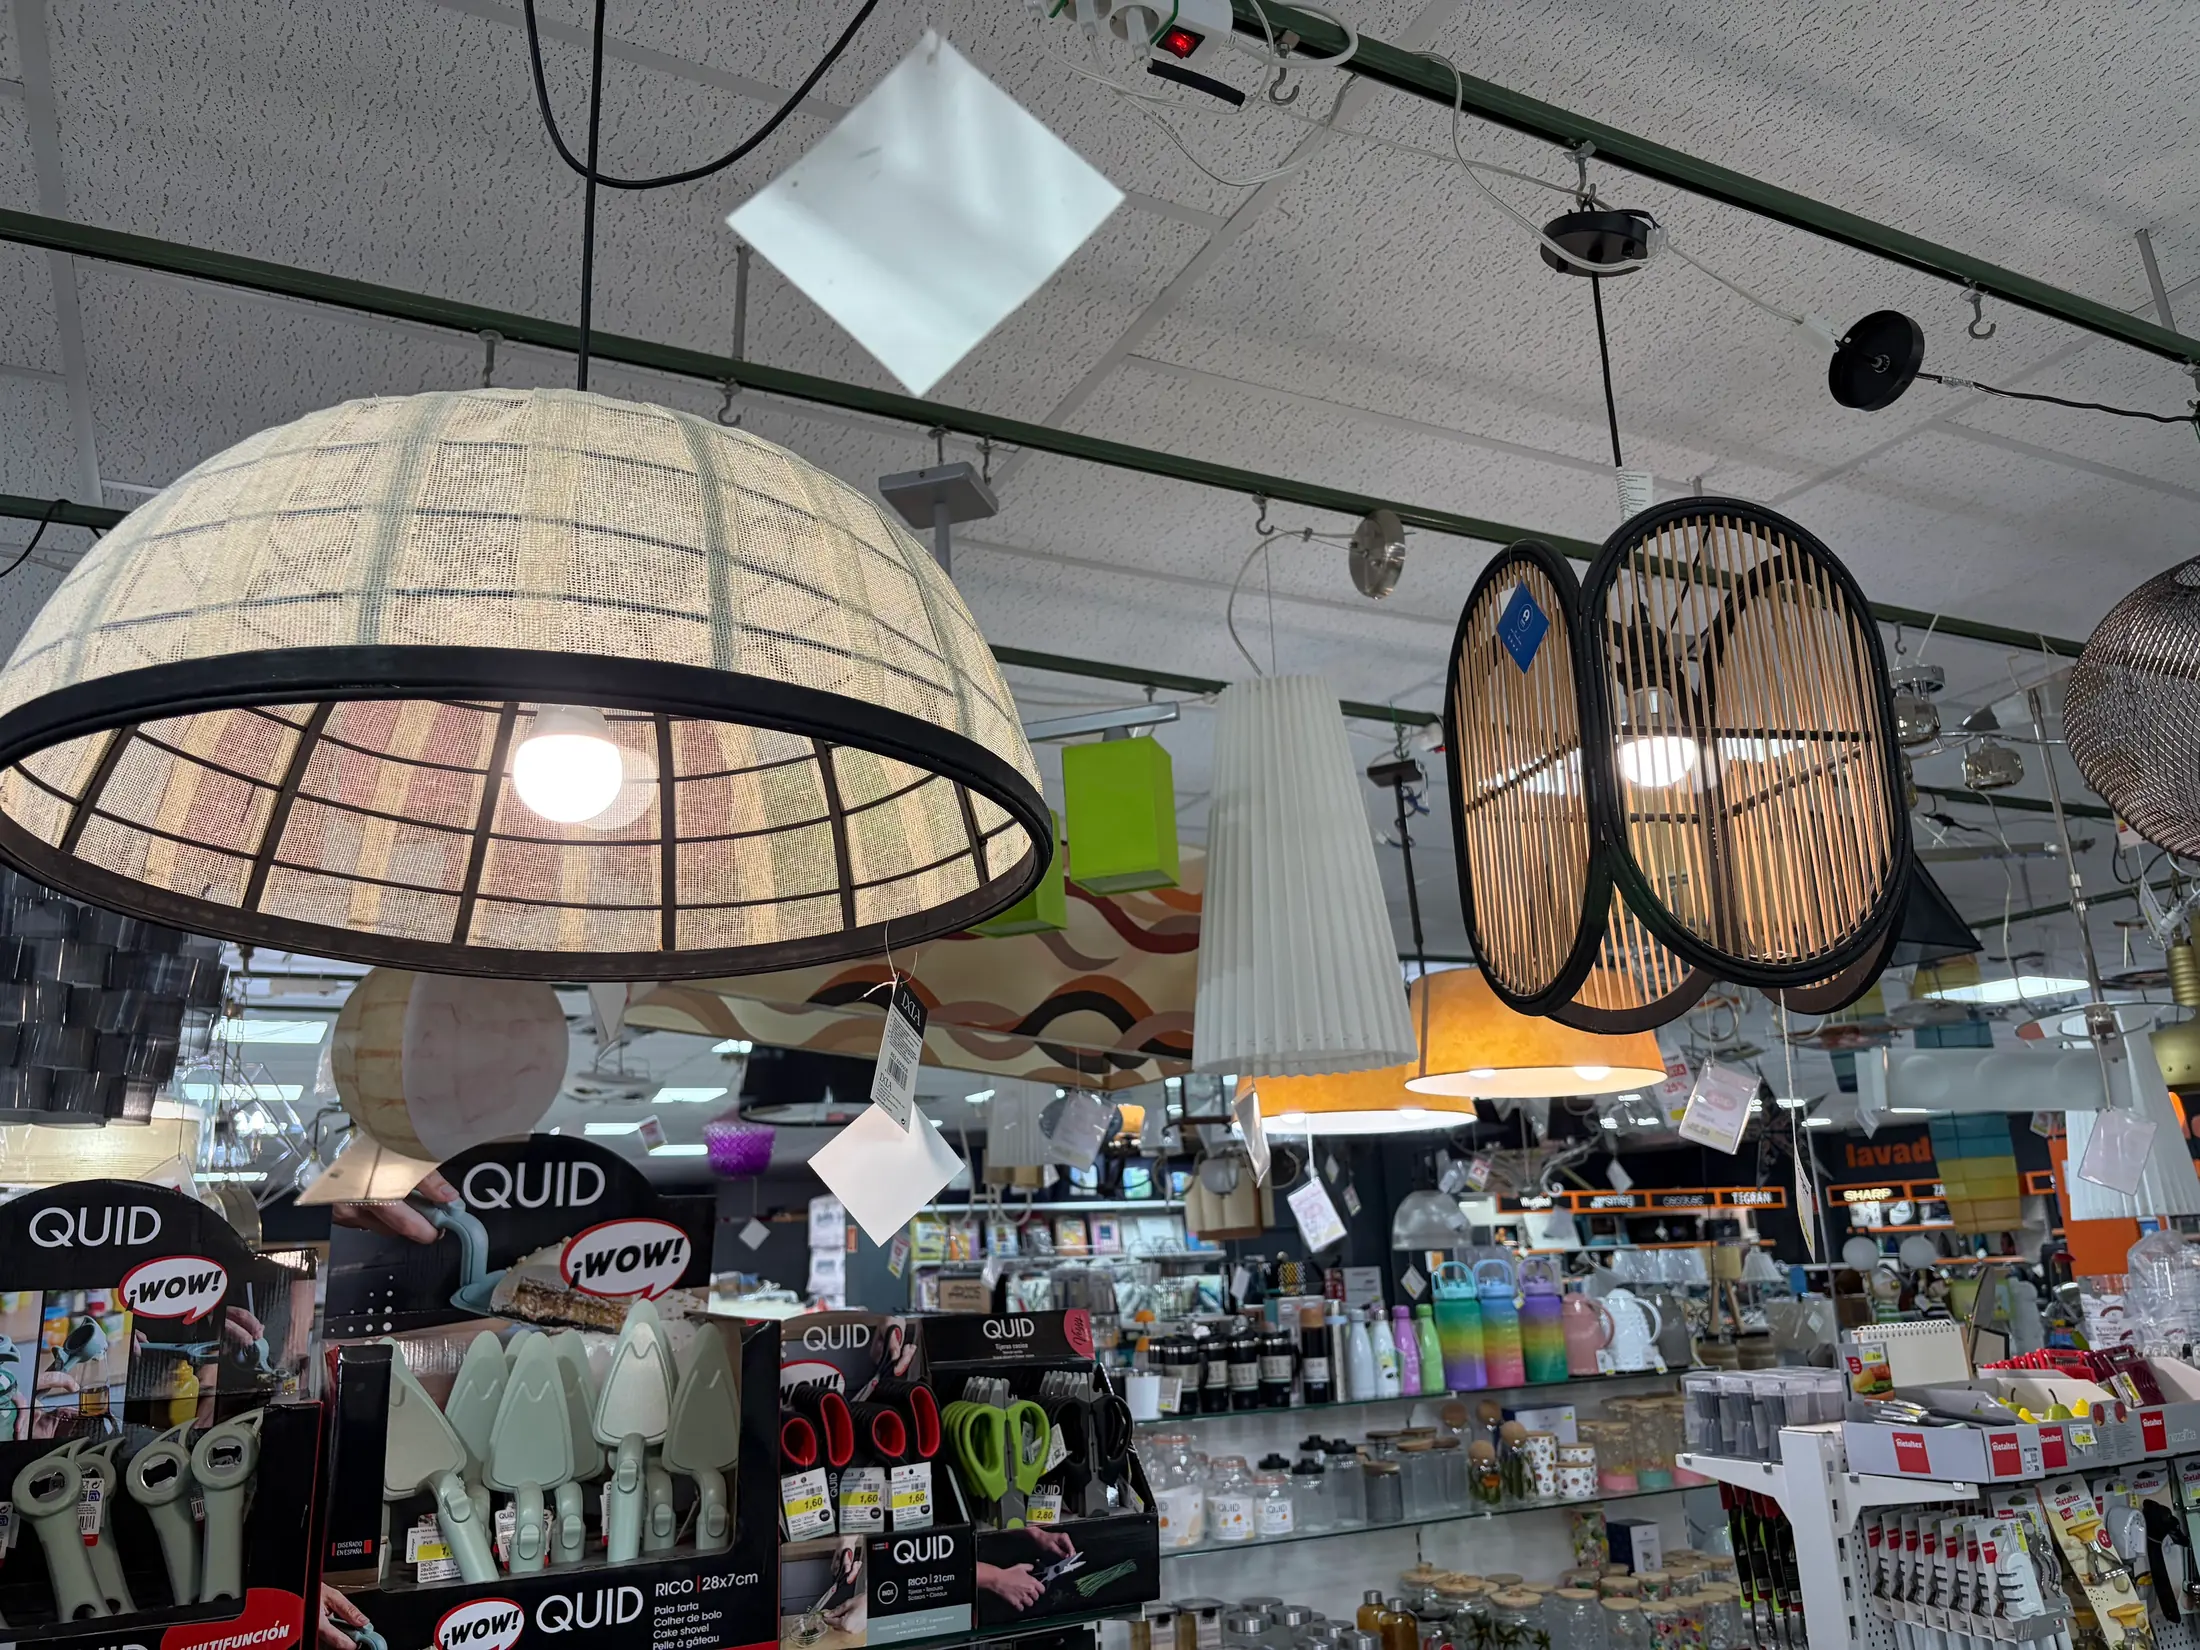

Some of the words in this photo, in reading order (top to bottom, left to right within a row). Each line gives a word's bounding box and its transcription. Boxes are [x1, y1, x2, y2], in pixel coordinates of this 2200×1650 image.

[1845, 1136, 1933, 1168] lavad
[463, 1161, 606, 1210] QUID
[1843, 1188, 1893, 1202] SHARP
[28, 1206, 162, 1248] QUID
[803, 1323, 870, 1351] QUID
[983, 1317, 1035, 1339] QUID
[829, 1472, 839, 1497] QUID
[1034, 1484, 1061, 1495] QUID
[893, 1535, 954, 1564] QUID
[655, 1579, 694, 1597] RICO
[701, 1572, 759, 1591] 28x7cm
[907, 1576, 928, 1587] RICO
[933, 1574, 955, 1583] 21cm
[536, 1586, 644, 1634] QUID
[653, 1616, 685, 1628] Colher
[686, 1615, 700, 1623] de
[701, 1610, 722, 1621] bolo
[654, 1606, 675, 1616] Pala
[677, 1602, 699, 1613] tarta
[652, 1640, 675, 1650] Pelle
[677, 1638, 684, 1648] à
[686, 1634, 720, 1649] gâteau
[653, 1628, 678, 1640] Cake
[680, 1624, 710, 1636] shovel
